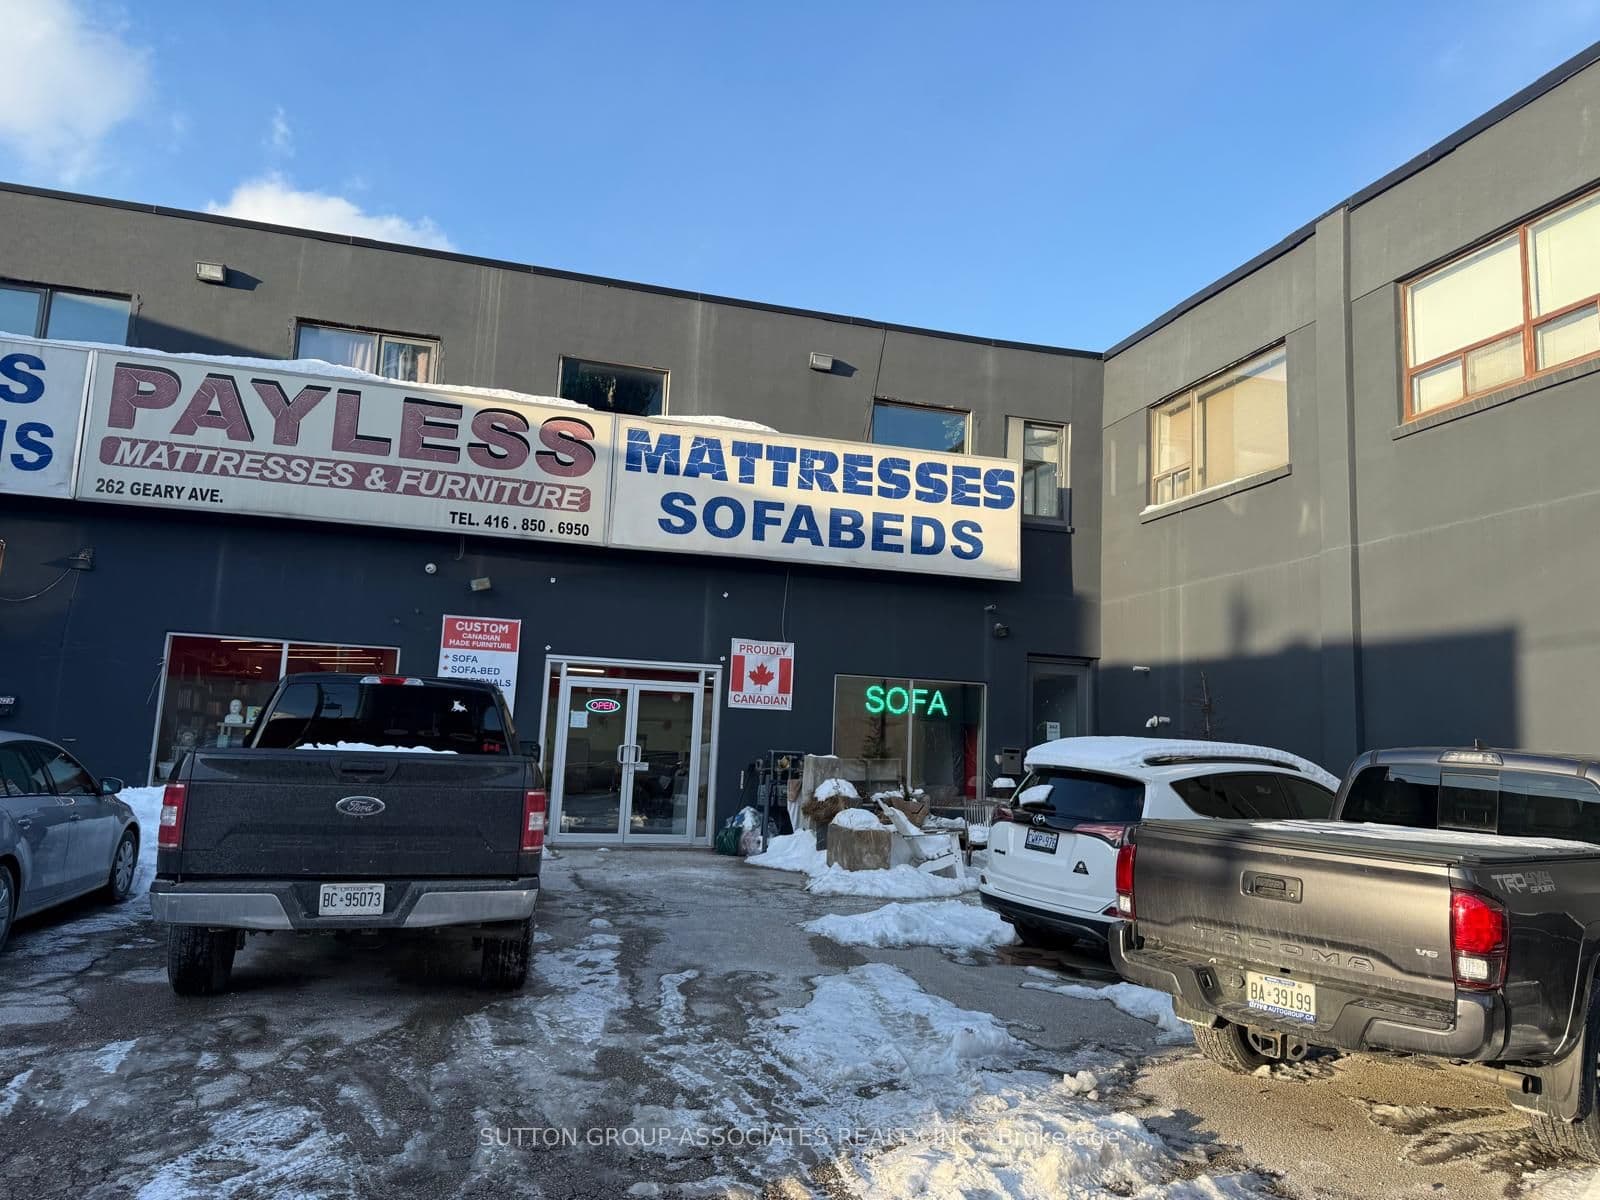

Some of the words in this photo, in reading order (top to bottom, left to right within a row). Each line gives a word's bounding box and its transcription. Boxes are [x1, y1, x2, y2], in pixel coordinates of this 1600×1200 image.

[107, 361, 597, 478] PAYLESS
[0, 419, 54, 471] S
[110, 439, 357, 488] MATTRESSES
[364, 466, 391, 492] &
[396, 469, 588, 510] FURNITURE
[625, 427, 1016, 510] MATTRESSES
[96, 478, 125, 495] 262
[130, 481, 186, 501] GEARY
[188, 486, 224, 504] AVE.
[449, 511, 480, 528] TEL.
[657, 491, 984, 561] SOFABEDS
[455, 621, 509, 634] CUSTOM
[448, 639, 471, 647] MADE
[472, 641, 511, 649] FURNITURE
[462, 633, 501, 641] CANADIAN
[739, 643, 788, 657] PROUDLY
[451, 654, 479, 664] SOFA
[450, 665, 501, 676] SOFA-BED
[590, 701, 616, 710] OPEN
[732, 693, 788, 706] CANADIAN
[864, 684, 949, 717] SOFA
[347, 800, 374, 812] Ford
[1192, 924, 1375, 973] TACOMA
[1415, 947, 1439, 958] V6
